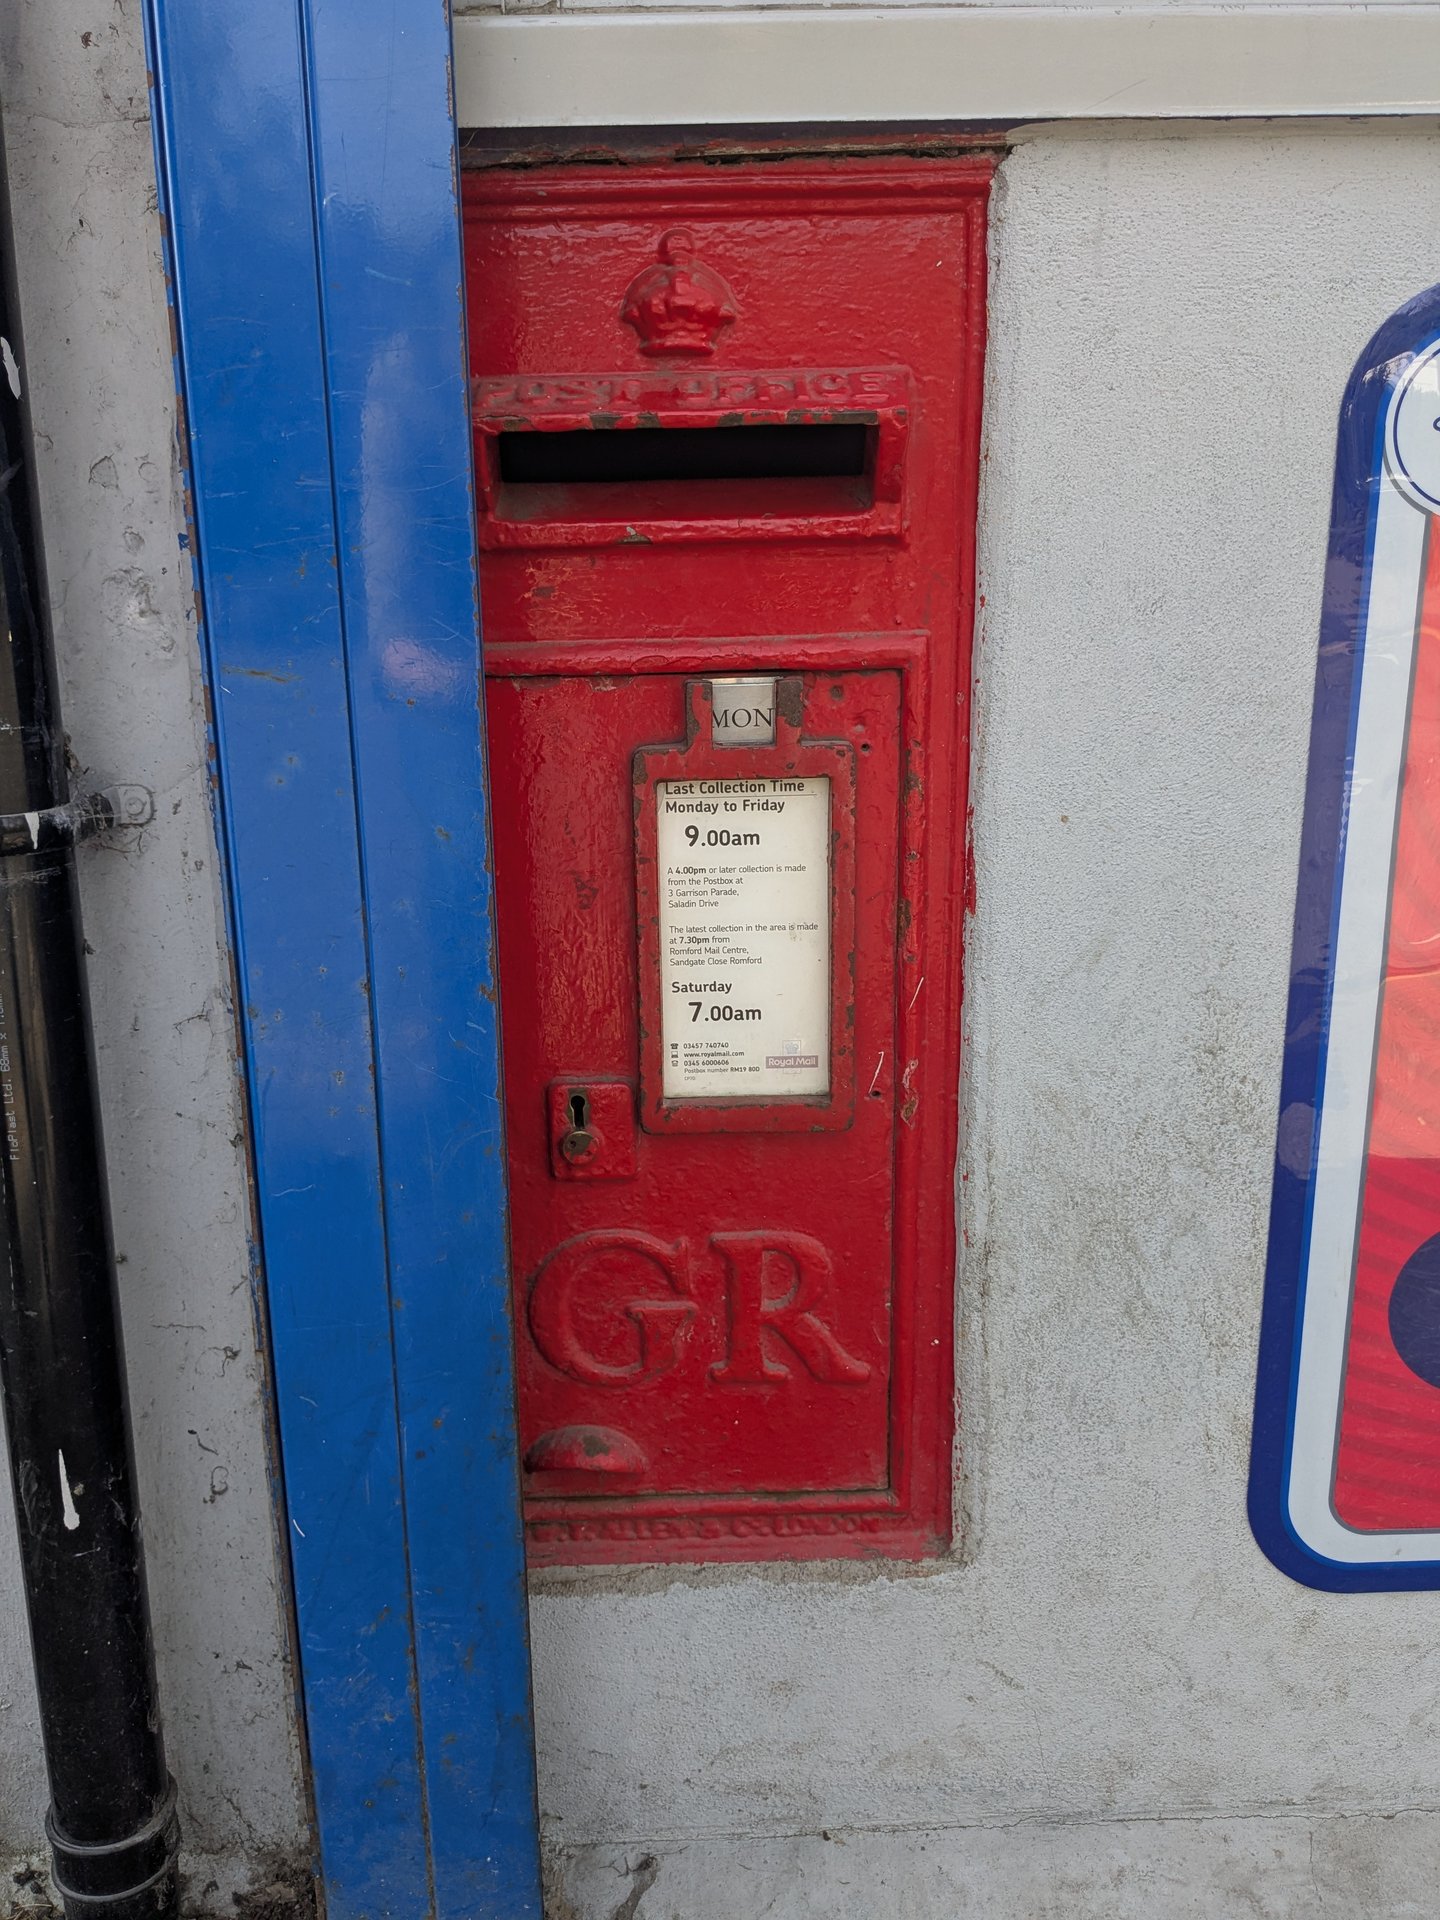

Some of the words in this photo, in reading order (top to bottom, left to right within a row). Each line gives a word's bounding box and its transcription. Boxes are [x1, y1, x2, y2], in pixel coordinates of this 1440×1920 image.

[473, 380, 641, 407] POST
[676, 371, 892, 404] OFFICE
[712, 708, 775, 728] MON
[665, 782, 694, 794] Last
[699, 781, 766, 794] Collection
[770, 780, 805, 792] Time
[666, 801, 719, 814] Monday
[724, 801, 737, 812] to
[743, 800, 785, 813] Friday
[685, 825, 760, 847] 9.00am
[676, 866, 706, 875] 4.00pm
[739, 865, 774, 873] collection
[668, 878, 686, 886] from
[704, 877, 733, 885] Postbox
[668, 889, 673, 897] 3
[676, 889, 708, 897] Garrison
[711, 888, 739, 896] Parade,
[668, 900, 696, 908] Saladin
[699, 899, 719, 907] Drive
[709, 924, 743, 932] collection
[789, 923, 795, 931] is
[679, 936, 709, 945] 7.30pm
[670, 947, 702, 955] Romford
[670, 958, 705, 967] Sandgate
[708, 957, 727, 965] Close
[672, 981, 732, 994] Saturday
[688, 1002, 761, 1022] 7.00am
[768, 1058, 795, 1067] Royal
[795, 1056, 817, 1065] Mail
[3, 1078, 14, 1105] Ltd.
[5, 1110, 20, 1161] FloPlast
